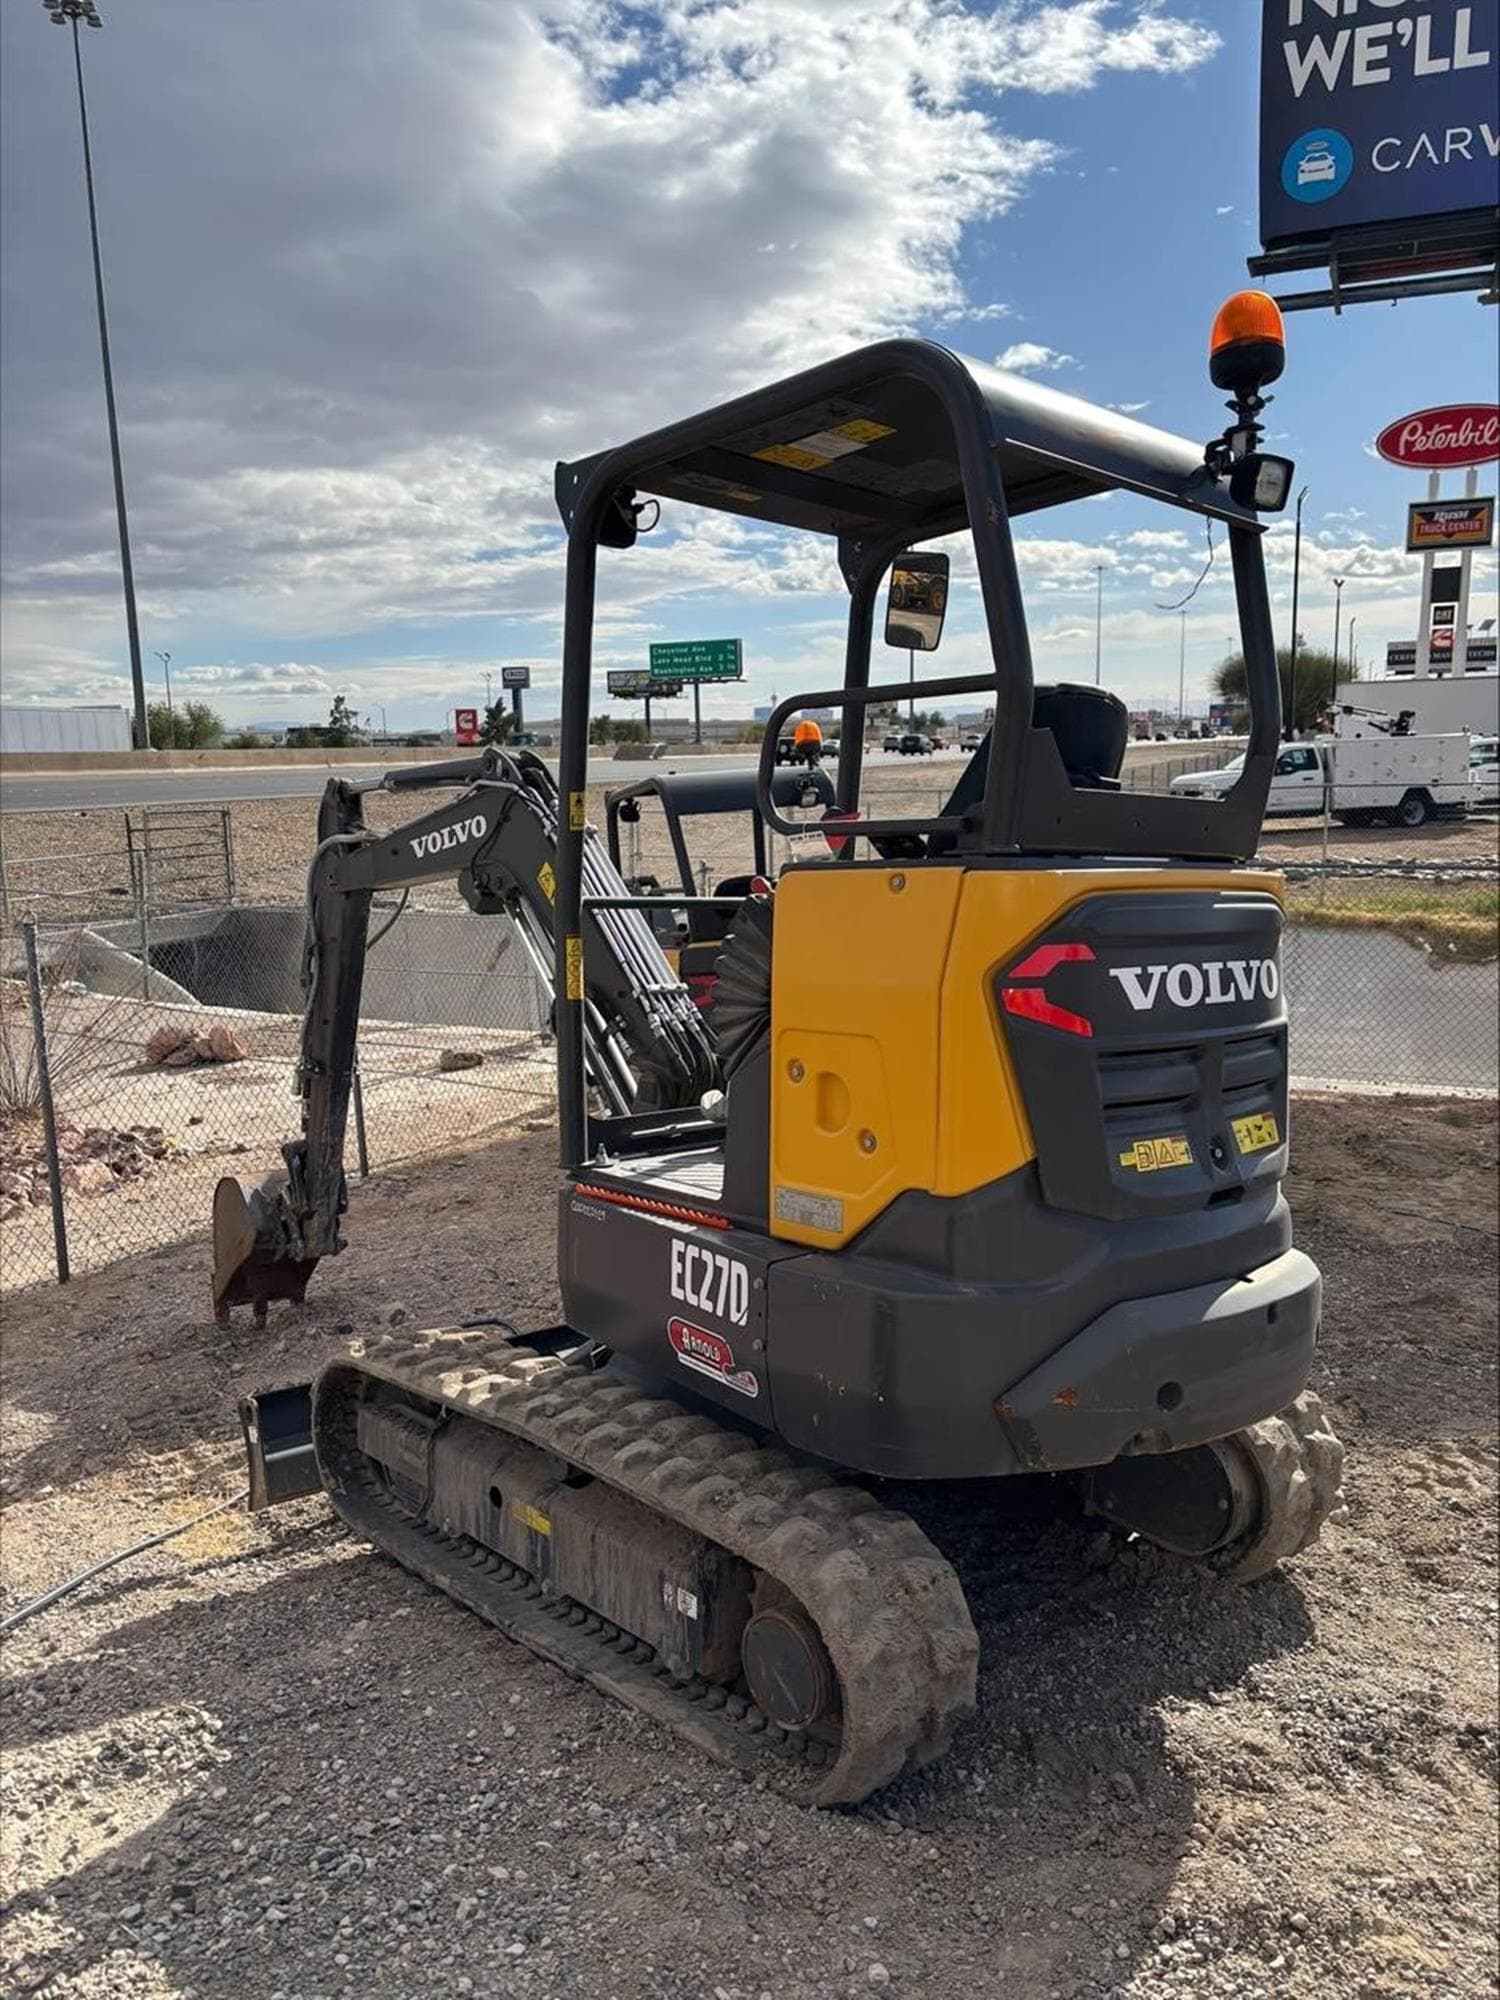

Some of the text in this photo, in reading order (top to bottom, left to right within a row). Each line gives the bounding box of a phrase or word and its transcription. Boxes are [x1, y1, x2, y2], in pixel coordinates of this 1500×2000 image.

[1283, 8, 1490, 98] WE'LL
[1399, 416, 1499, 456] Peterbil
[409, 815, 487, 858] VOLVO
[1109, 958, 1279, 1011] VOLVO
[671, 1238, 748, 1326] EC27D
